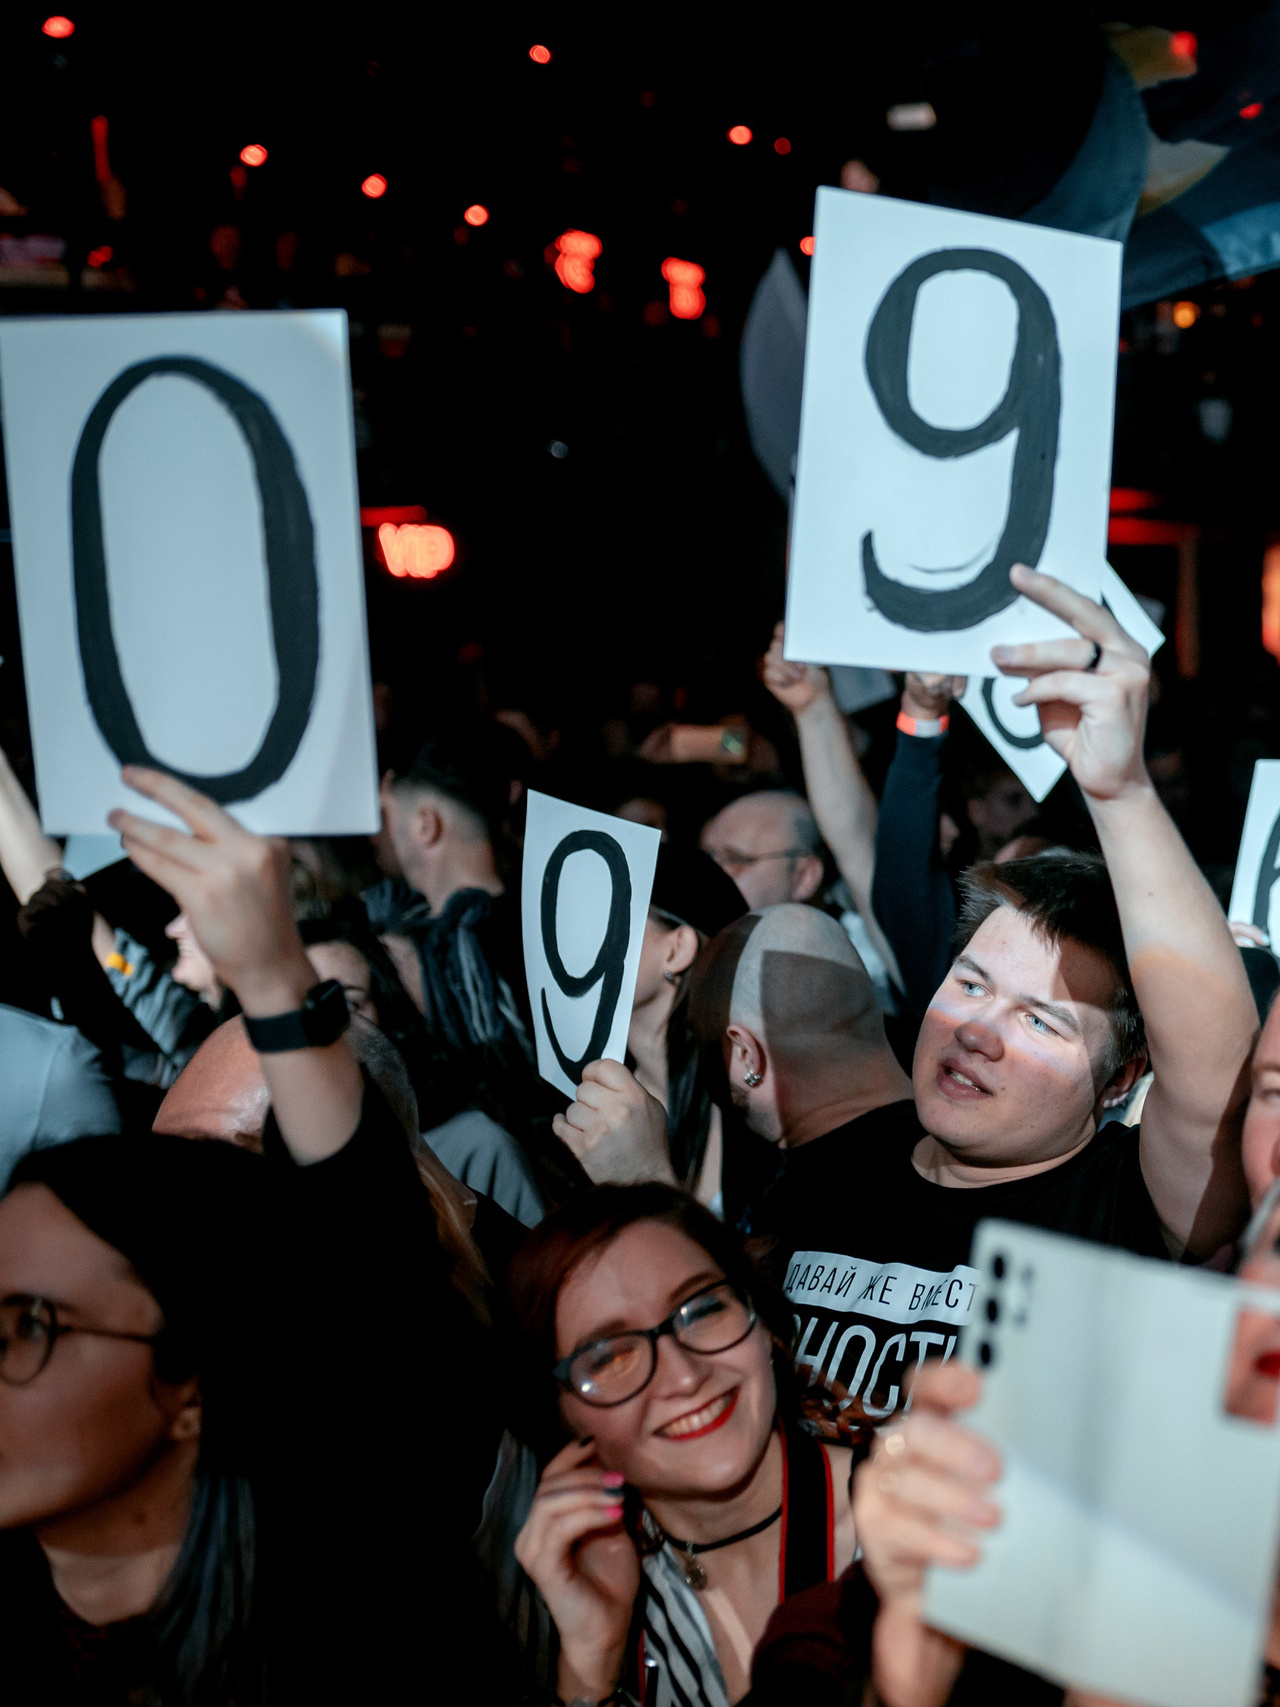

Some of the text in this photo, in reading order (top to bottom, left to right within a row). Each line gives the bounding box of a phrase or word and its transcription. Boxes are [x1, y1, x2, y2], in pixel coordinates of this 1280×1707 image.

[70, 354, 322, 806] 0
[861, 246, 1064, 634] 9
[541, 830, 632, 1086] 9
[786, 1263, 857, 1298] ДАВАЙ
[858, 1274, 898, 1304] ЖЕ
